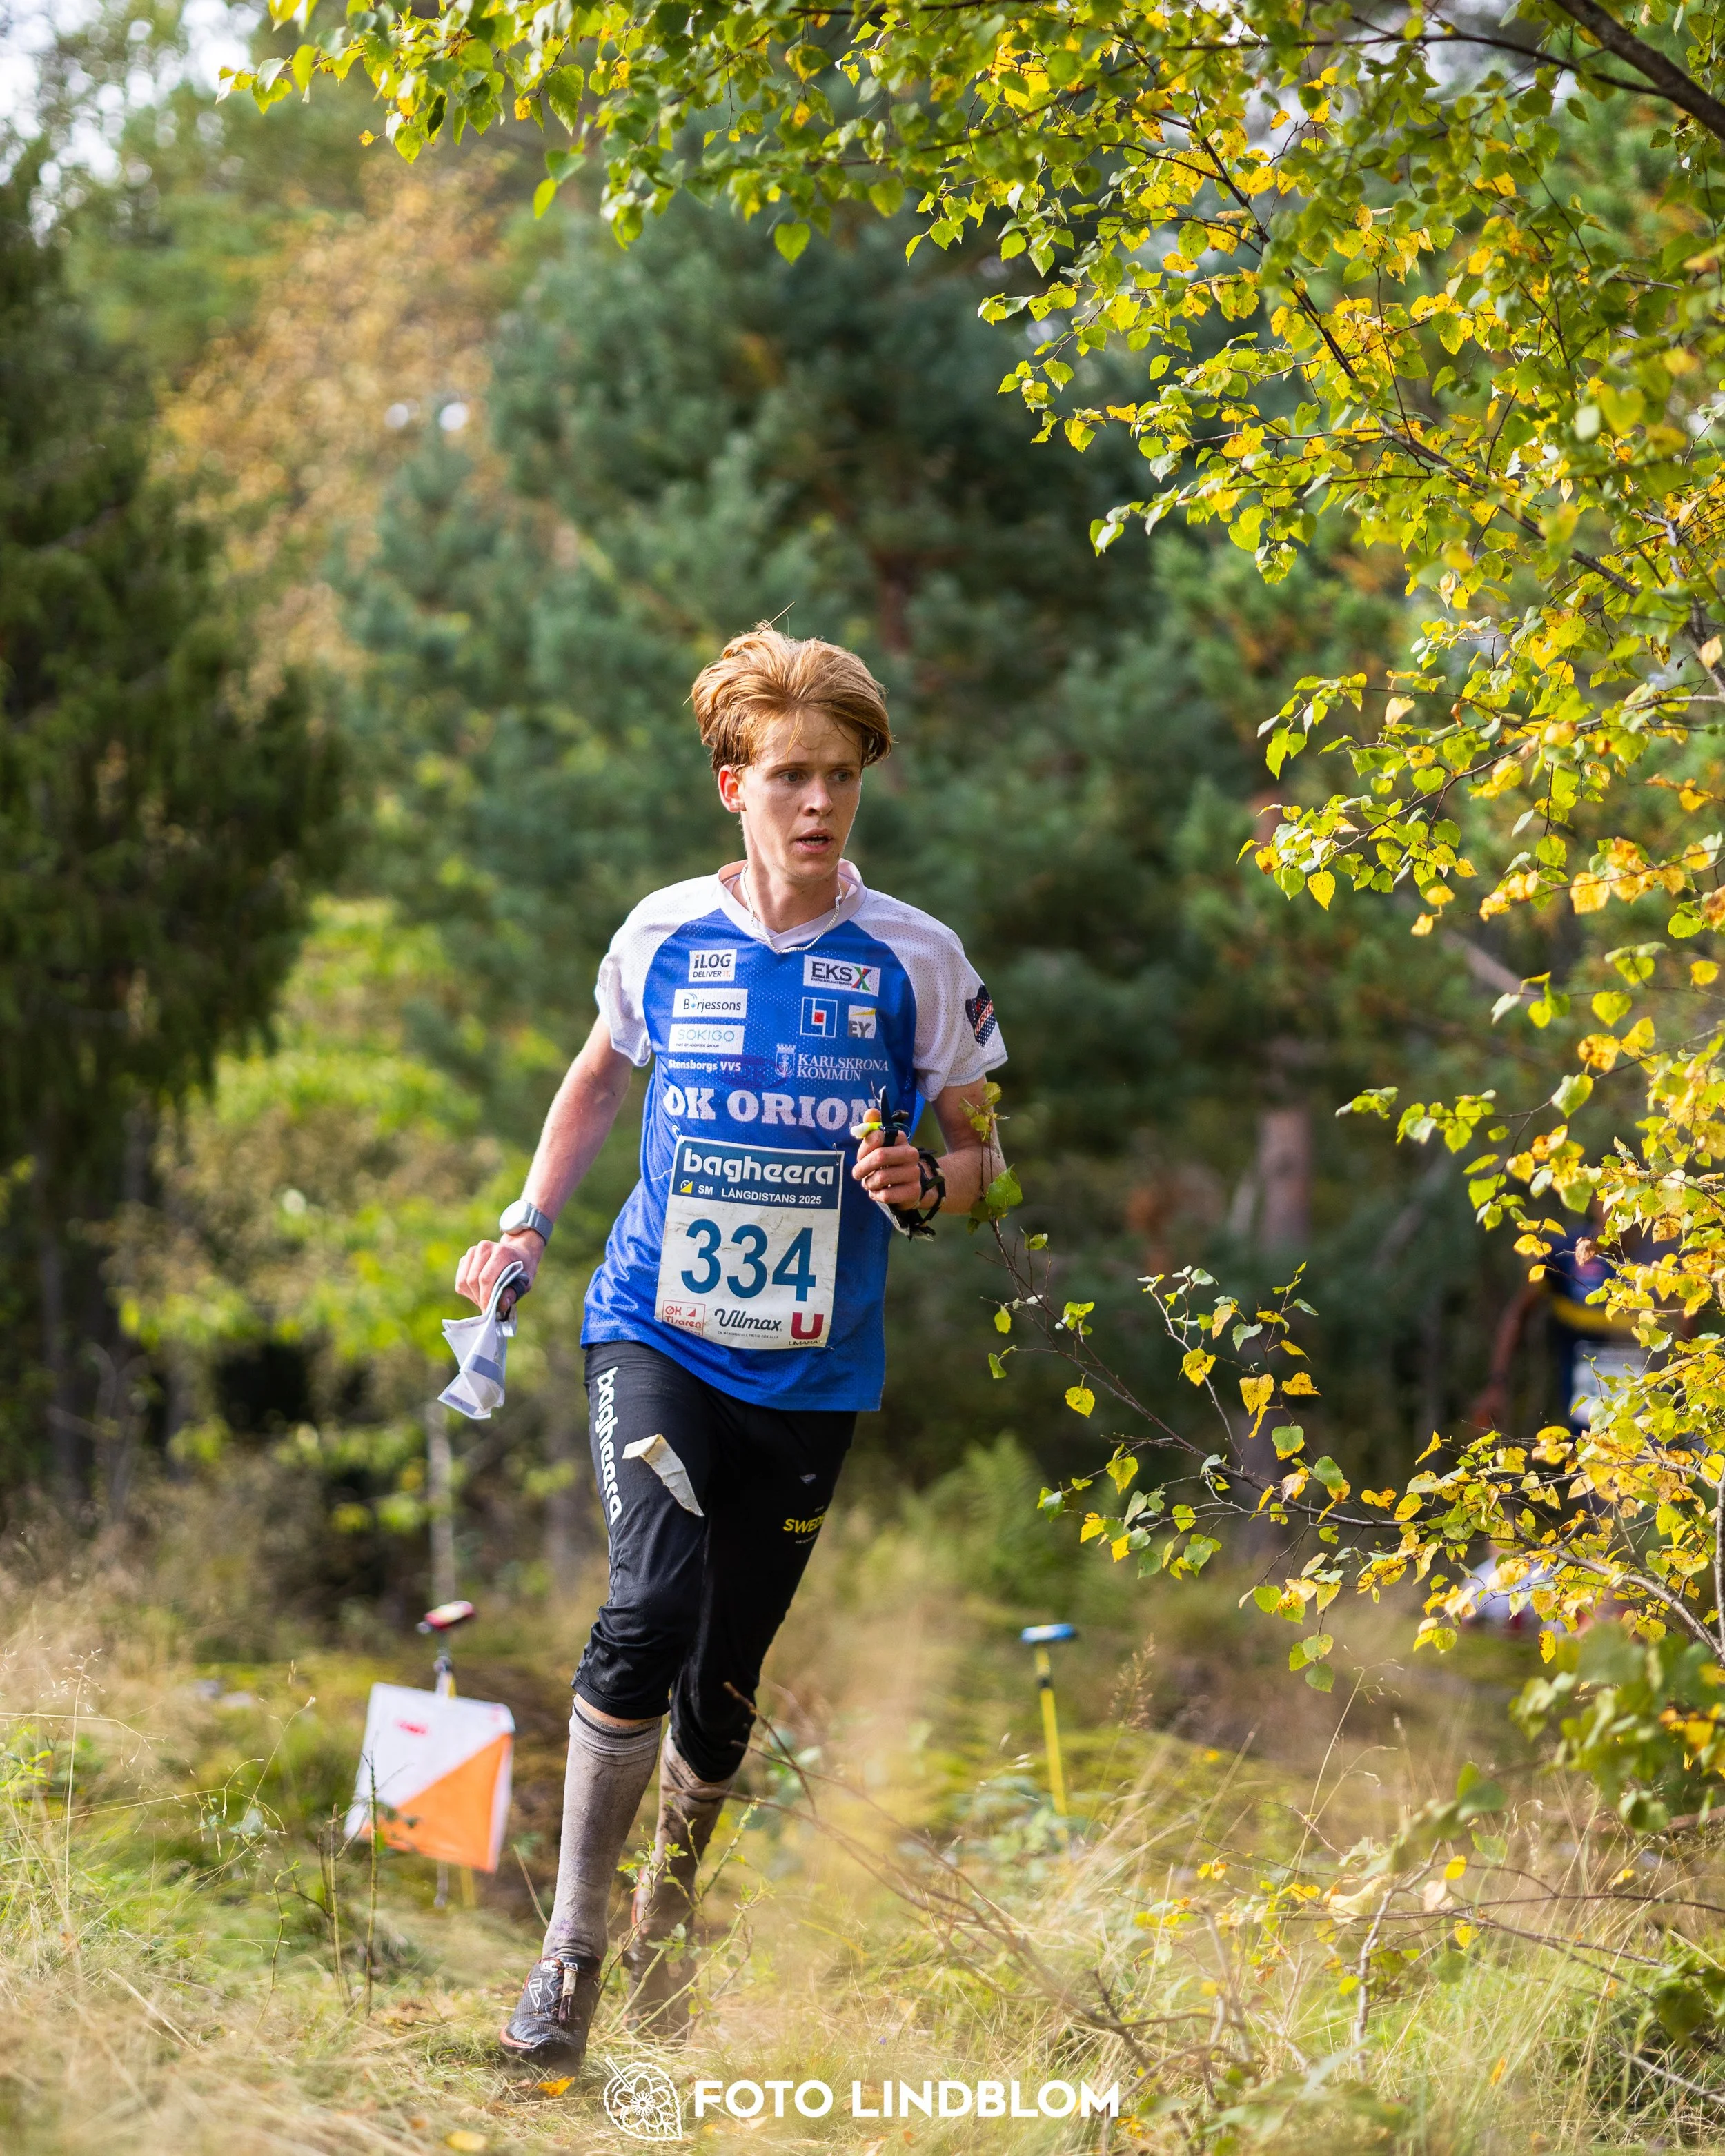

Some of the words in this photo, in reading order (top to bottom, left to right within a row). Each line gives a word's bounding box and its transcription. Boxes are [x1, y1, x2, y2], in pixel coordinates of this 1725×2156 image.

[694, 953, 731, 968] iLOG
[678, 1029, 734, 1042] SOKIGO
[848, 1020, 872, 1038] EY
[668, 1059, 718, 1073] Stensborgs
[720, 1061, 742, 1071] VVS
[796, 1052, 889, 1071] KARLSKRONA
[796, 1066, 862, 1081] KOMMUN
[663, 1085, 716, 1120] OK
[683, 1148, 834, 1185] bagheera
[698, 1185, 713, 1195] SM
[721, 1187, 796, 1203] LÅNGDISTANS
[798, 1195, 822, 1204] 2025
[681, 1218, 816, 1302] 334
[665, 1316, 702, 1329] Tisaren
[714, 1308, 782, 1332] Ullmax
[595, 1366, 622, 1525] bagheera
